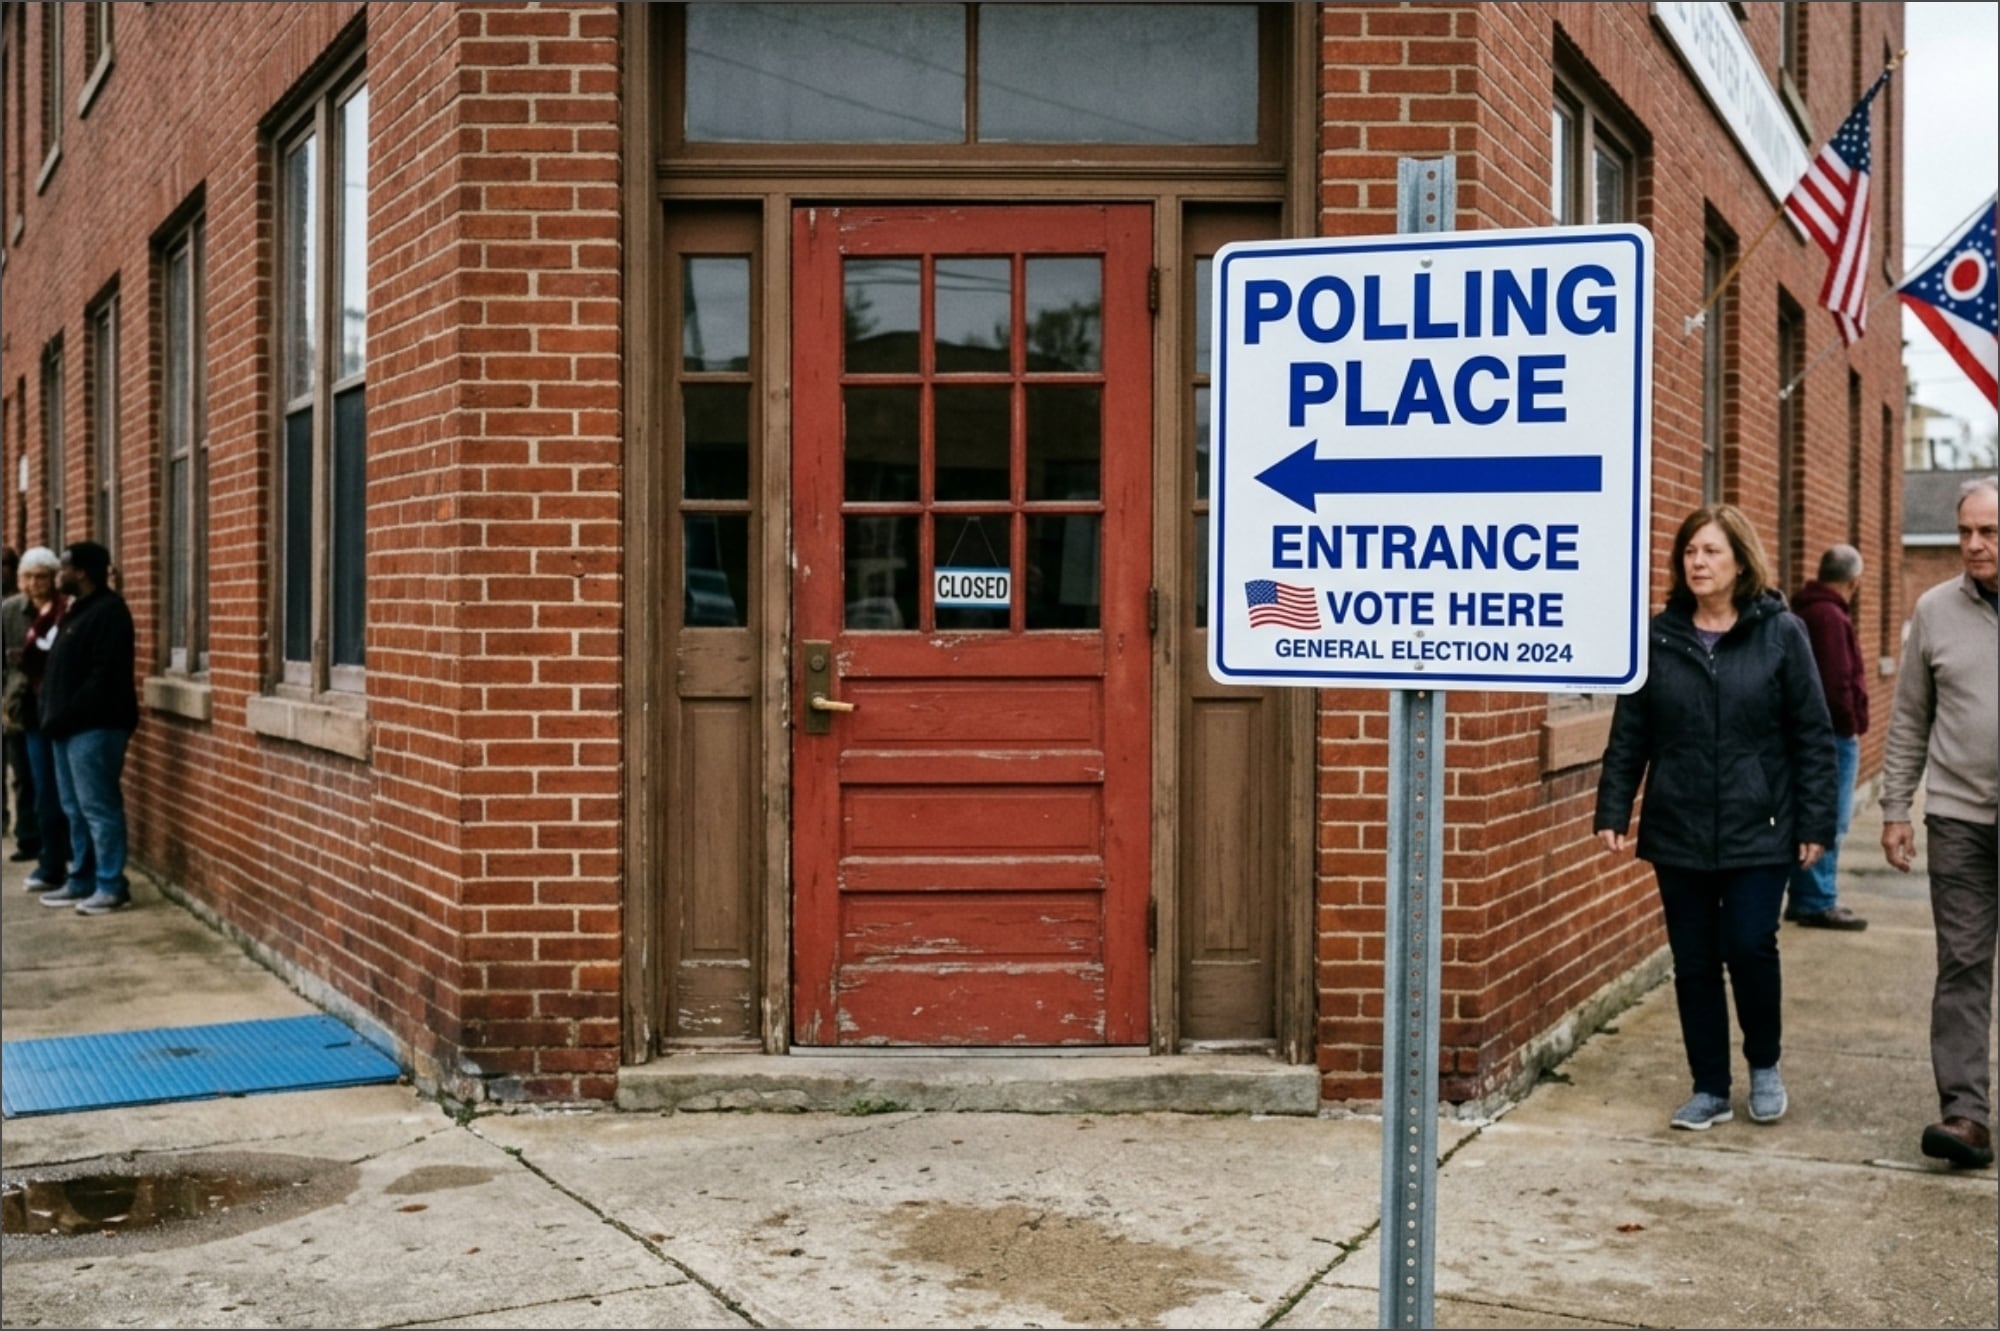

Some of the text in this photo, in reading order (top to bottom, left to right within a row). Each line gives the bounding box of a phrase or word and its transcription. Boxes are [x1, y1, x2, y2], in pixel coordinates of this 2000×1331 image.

[1243, 264, 1617, 345] POLLING
[1288, 354, 1567, 428] PLACE
[1271, 523, 1580, 571] ENTRANCE
[937, 575, 1008, 599] CLOSED
[1326, 590, 1564, 628] VOTE HERE
[1275, 638, 1573, 663] GENERAL ELECTION 2024
